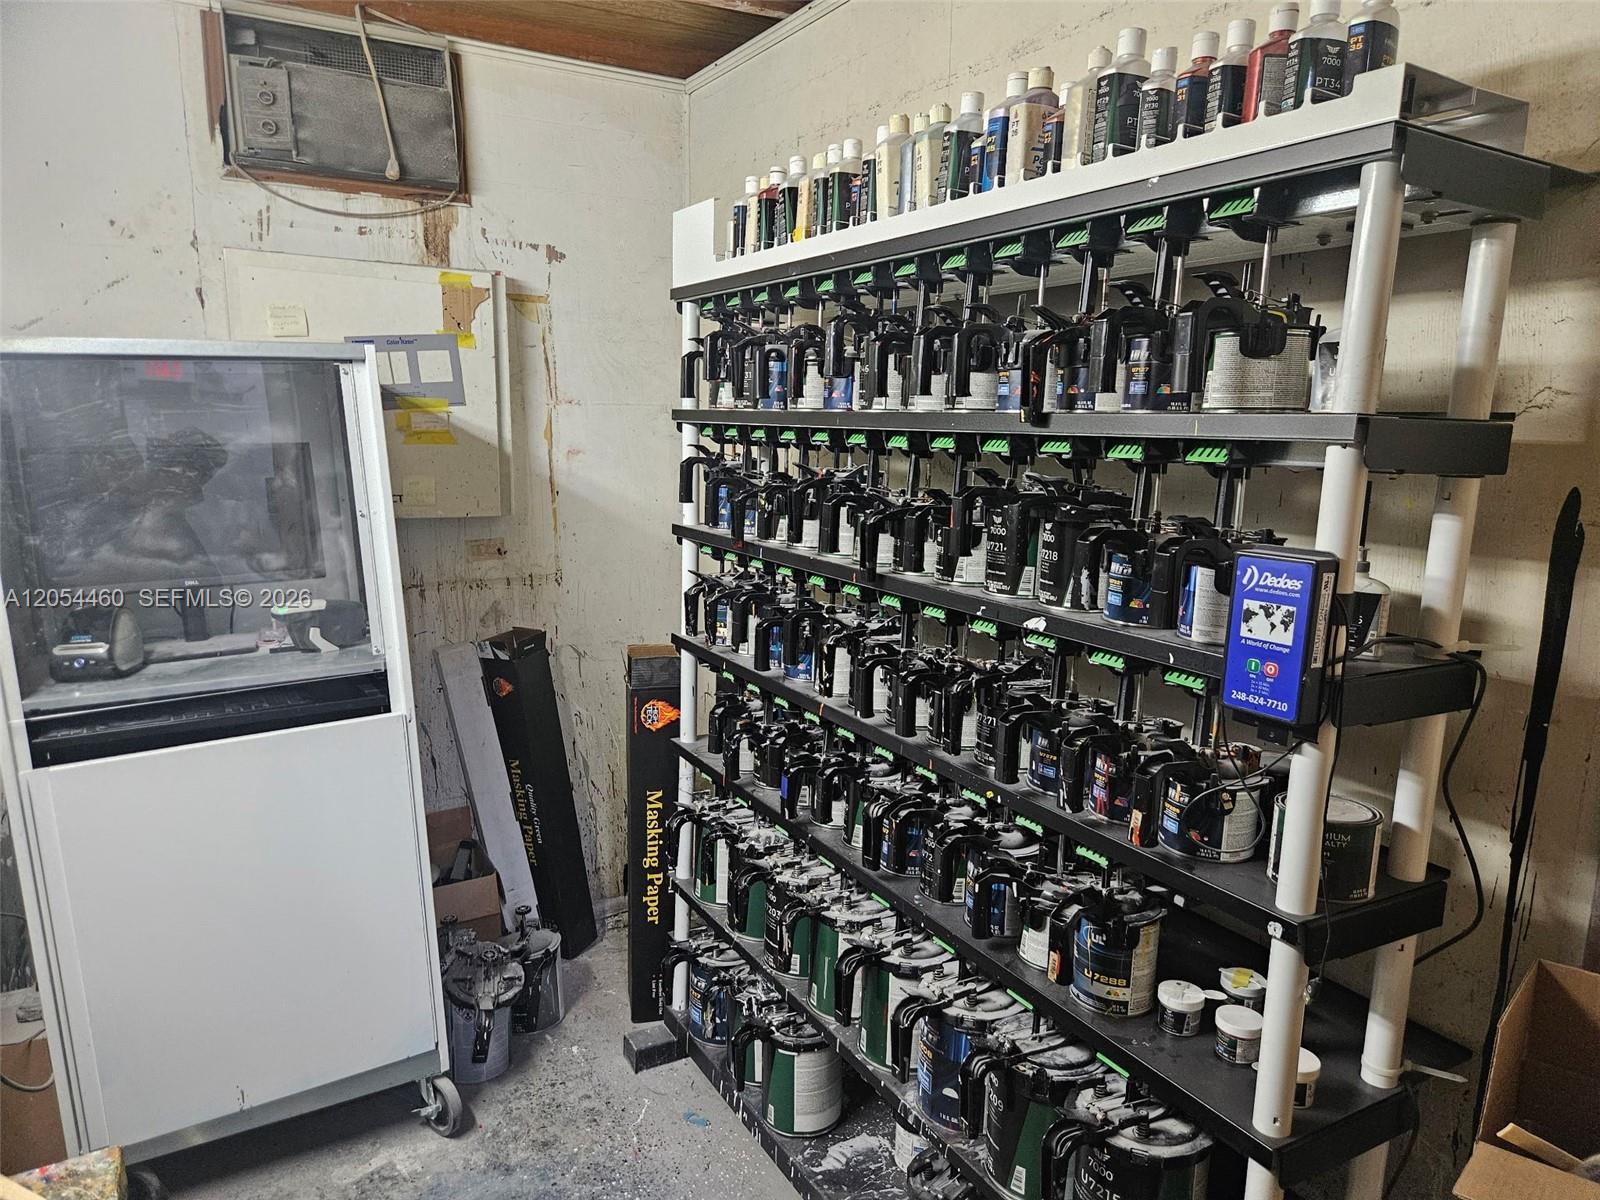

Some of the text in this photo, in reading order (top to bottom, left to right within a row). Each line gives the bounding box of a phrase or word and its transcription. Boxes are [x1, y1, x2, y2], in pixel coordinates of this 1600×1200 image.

[1321, 56, 1341, 67] 7000
[1315, 76, 1341, 89] PT34
[989, 526, 1007, 536] 7000
[1254, 586, 1301, 598] www.dedoes.com
[1259, 571, 1304, 592] Dedoes
[1246, 639, 1262, 649] World
[1269, 642, 1291, 654] Change
[1231, 689, 1289, 712] 248-624-7710
[508, 759, 537, 867] Masking Paper
[525, 783, 543, 845] Quality Green
[642, 789, 663, 925] Masking Paper
[1083, 966, 1127, 987] U7288
[1087, 1155, 1114, 1182] 7000
